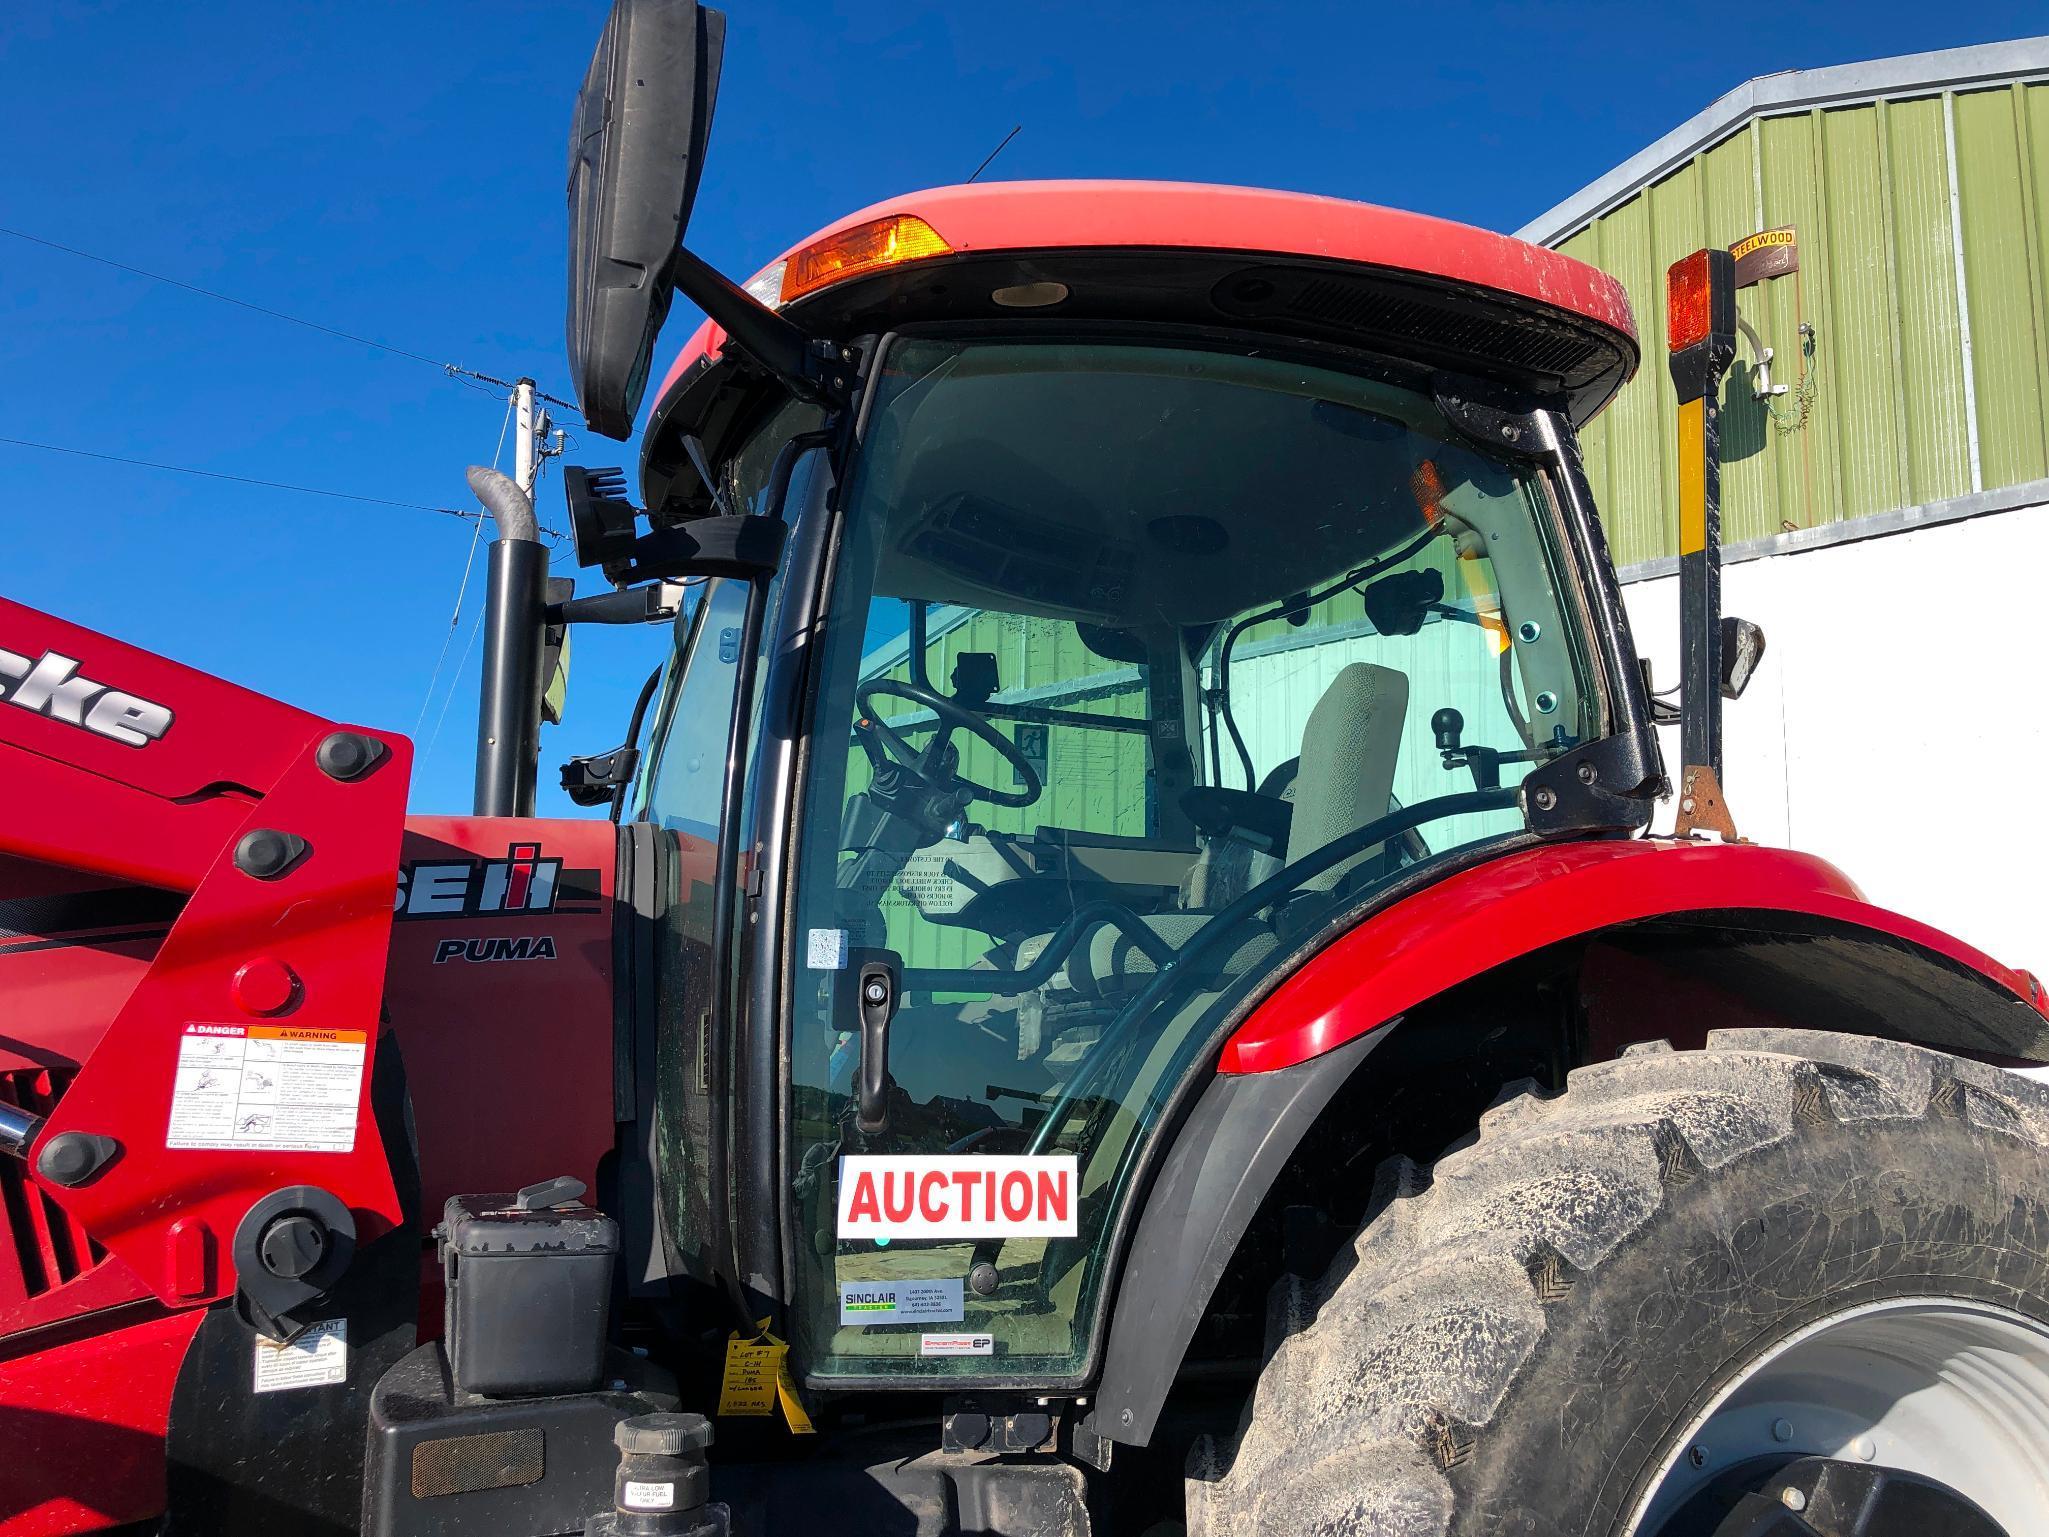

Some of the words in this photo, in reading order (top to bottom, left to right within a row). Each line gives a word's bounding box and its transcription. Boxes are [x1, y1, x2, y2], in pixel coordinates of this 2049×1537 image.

[433, 936, 557, 964] PUMA
[197, 1024, 245, 1036] DANGER
[290, 1031, 337, 1040] WARNING
[848, 1170, 1068, 1223] AUCTION
[845, 1293, 896, 1304] SINCLAIR
[973, 1339, 990, 1348] EP
